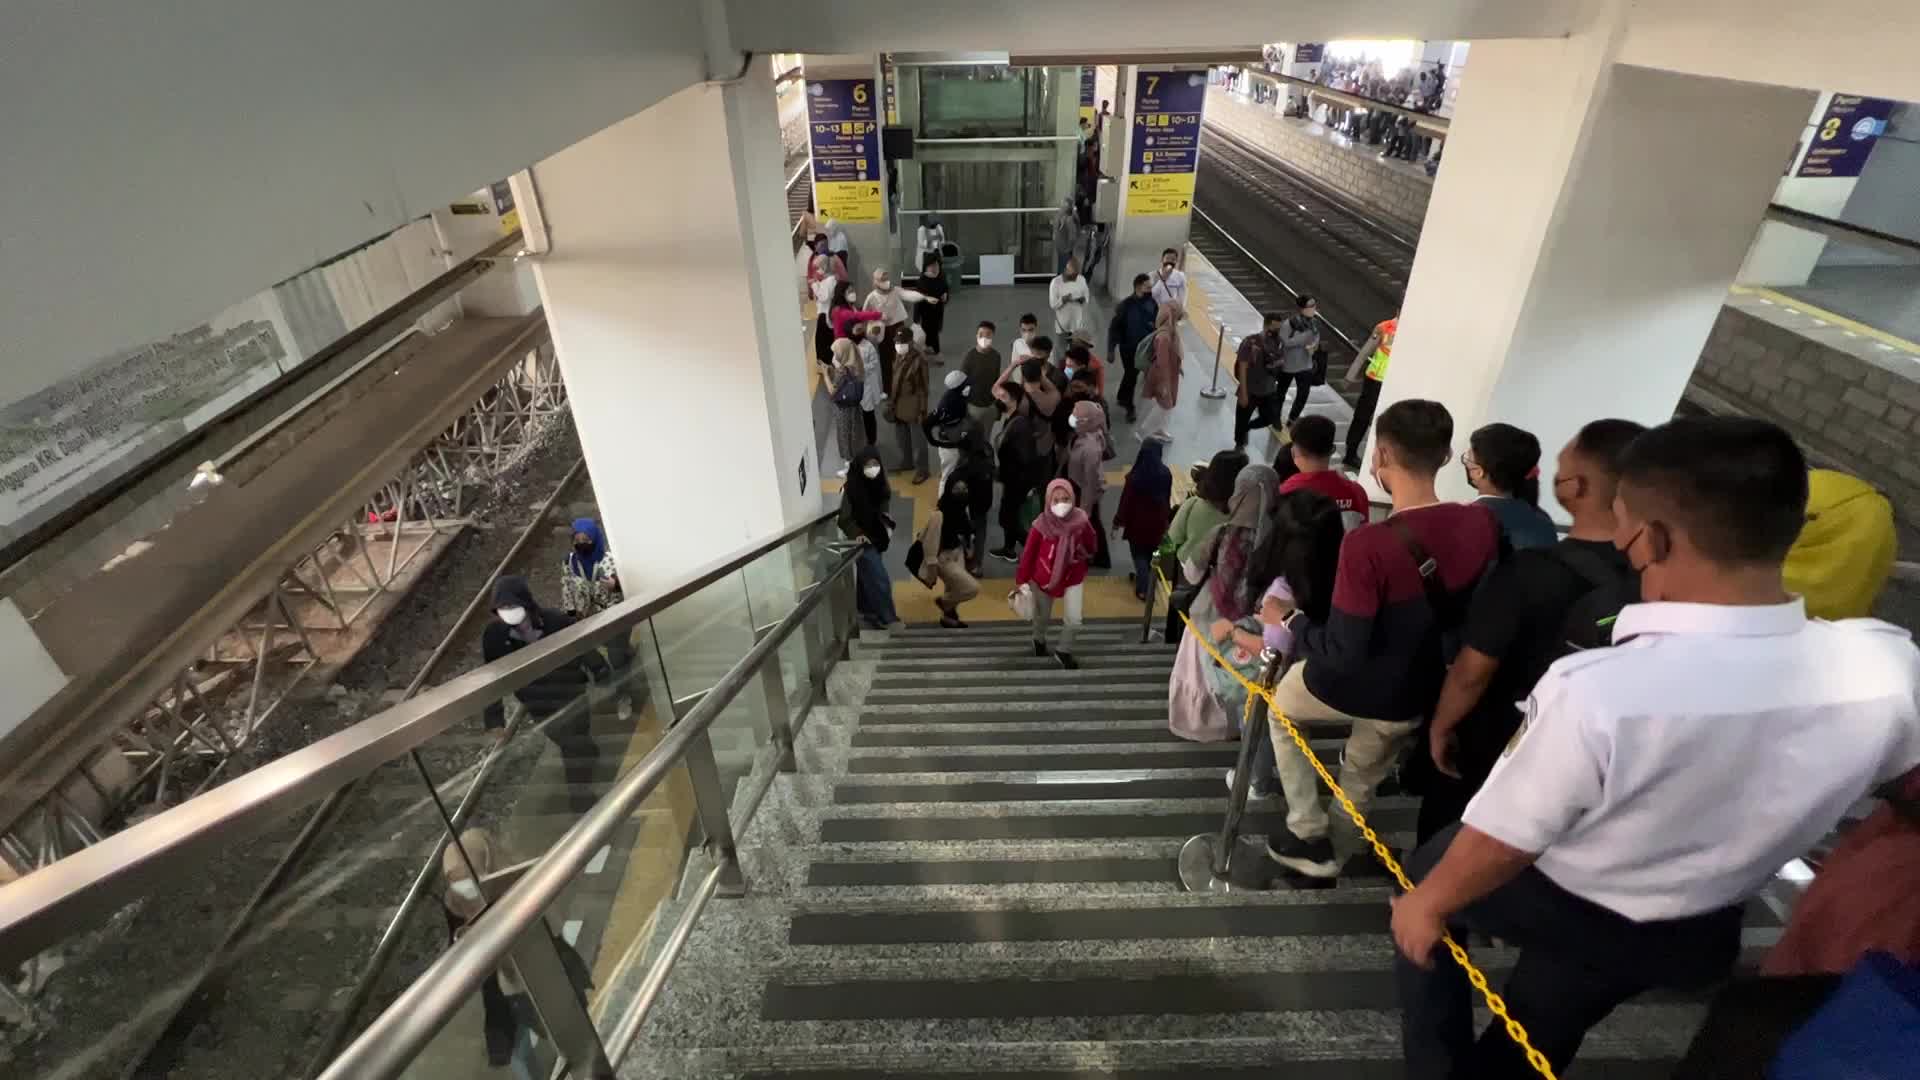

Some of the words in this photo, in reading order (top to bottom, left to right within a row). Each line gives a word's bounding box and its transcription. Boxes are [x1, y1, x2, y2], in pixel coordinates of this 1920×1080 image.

[853, 83, 868, 104] 6
[1145, 76, 1160, 96] 7
[1819, 117, 1842, 141] 8
[35, 447, 63, 470] KRL
[57, 431, 90, 457] Dapat
